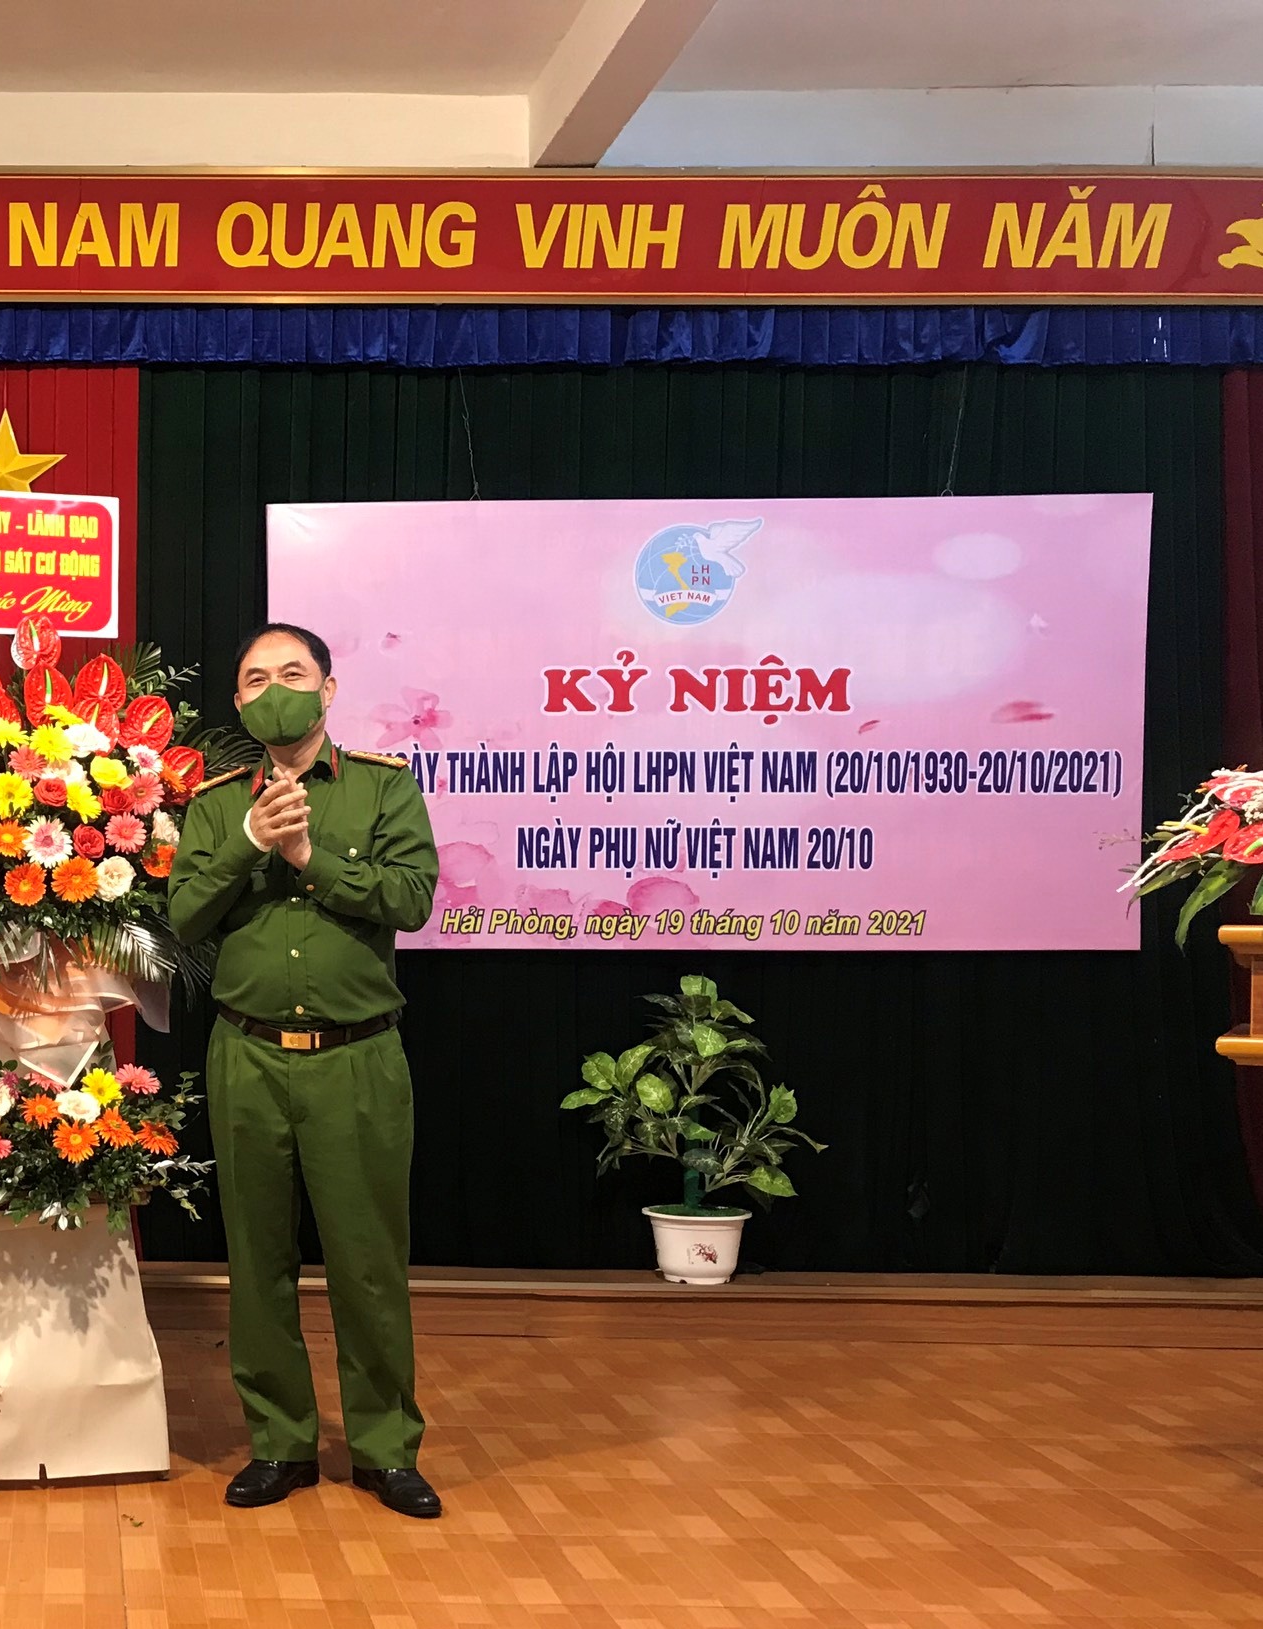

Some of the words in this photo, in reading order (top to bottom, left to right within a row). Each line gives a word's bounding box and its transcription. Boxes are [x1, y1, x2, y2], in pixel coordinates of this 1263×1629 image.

[9, 203, 179, 268] NAM
[217, 202, 476, 268] QUANG
[517, 204, 683, 269] VINH
[719, 185, 950, 270] MUÔN
[984, 186, 1171, 269] NĂM
[69, 515, 99, 543] ĐẠO
[4, 547, 33, 575] SÁT
[35, 550, 57, 576] CƠ
[59, 550, 101, 580] ĐỘNG
[20, 586, 93, 623] Mừng
[687, 592, 711, 603] NAM
[543, 650, 648, 713] KỶ
[669, 654, 851, 724] NIỆM
[447, 743, 525, 793] THÀNH
[534, 742, 578, 802] LẬP
[586, 742, 625, 802] HỘI
[633, 751, 696, 793] LHPN
[704, 742, 754, 802] VIỆT
[761, 751, 817, 793] NAM
[826, 750, 1123, 798] (20/10/1930-20/10/2021)
[517, 818, 582, 869] NGÀY
[589, 827, 637, 878] PHỤ
[645, 818, 682, 869] NỮ
[686, 818, 736, 878] VIỆT
[743, 827, 799, 869] NAM
[807, 827, 874, 870] 20/10
[441, 905, 485, 935] Hải
[489, 908, 578, 940] Phòng,
[585, 909, 650, 940] ngày
[655, 910, 685, 935] 19
[690, 909, 764, 940] tháng
[770, 910, 801, 935] 10
[805, 910, 861, 935] năm
[866, 910, 927, 936] 2021
